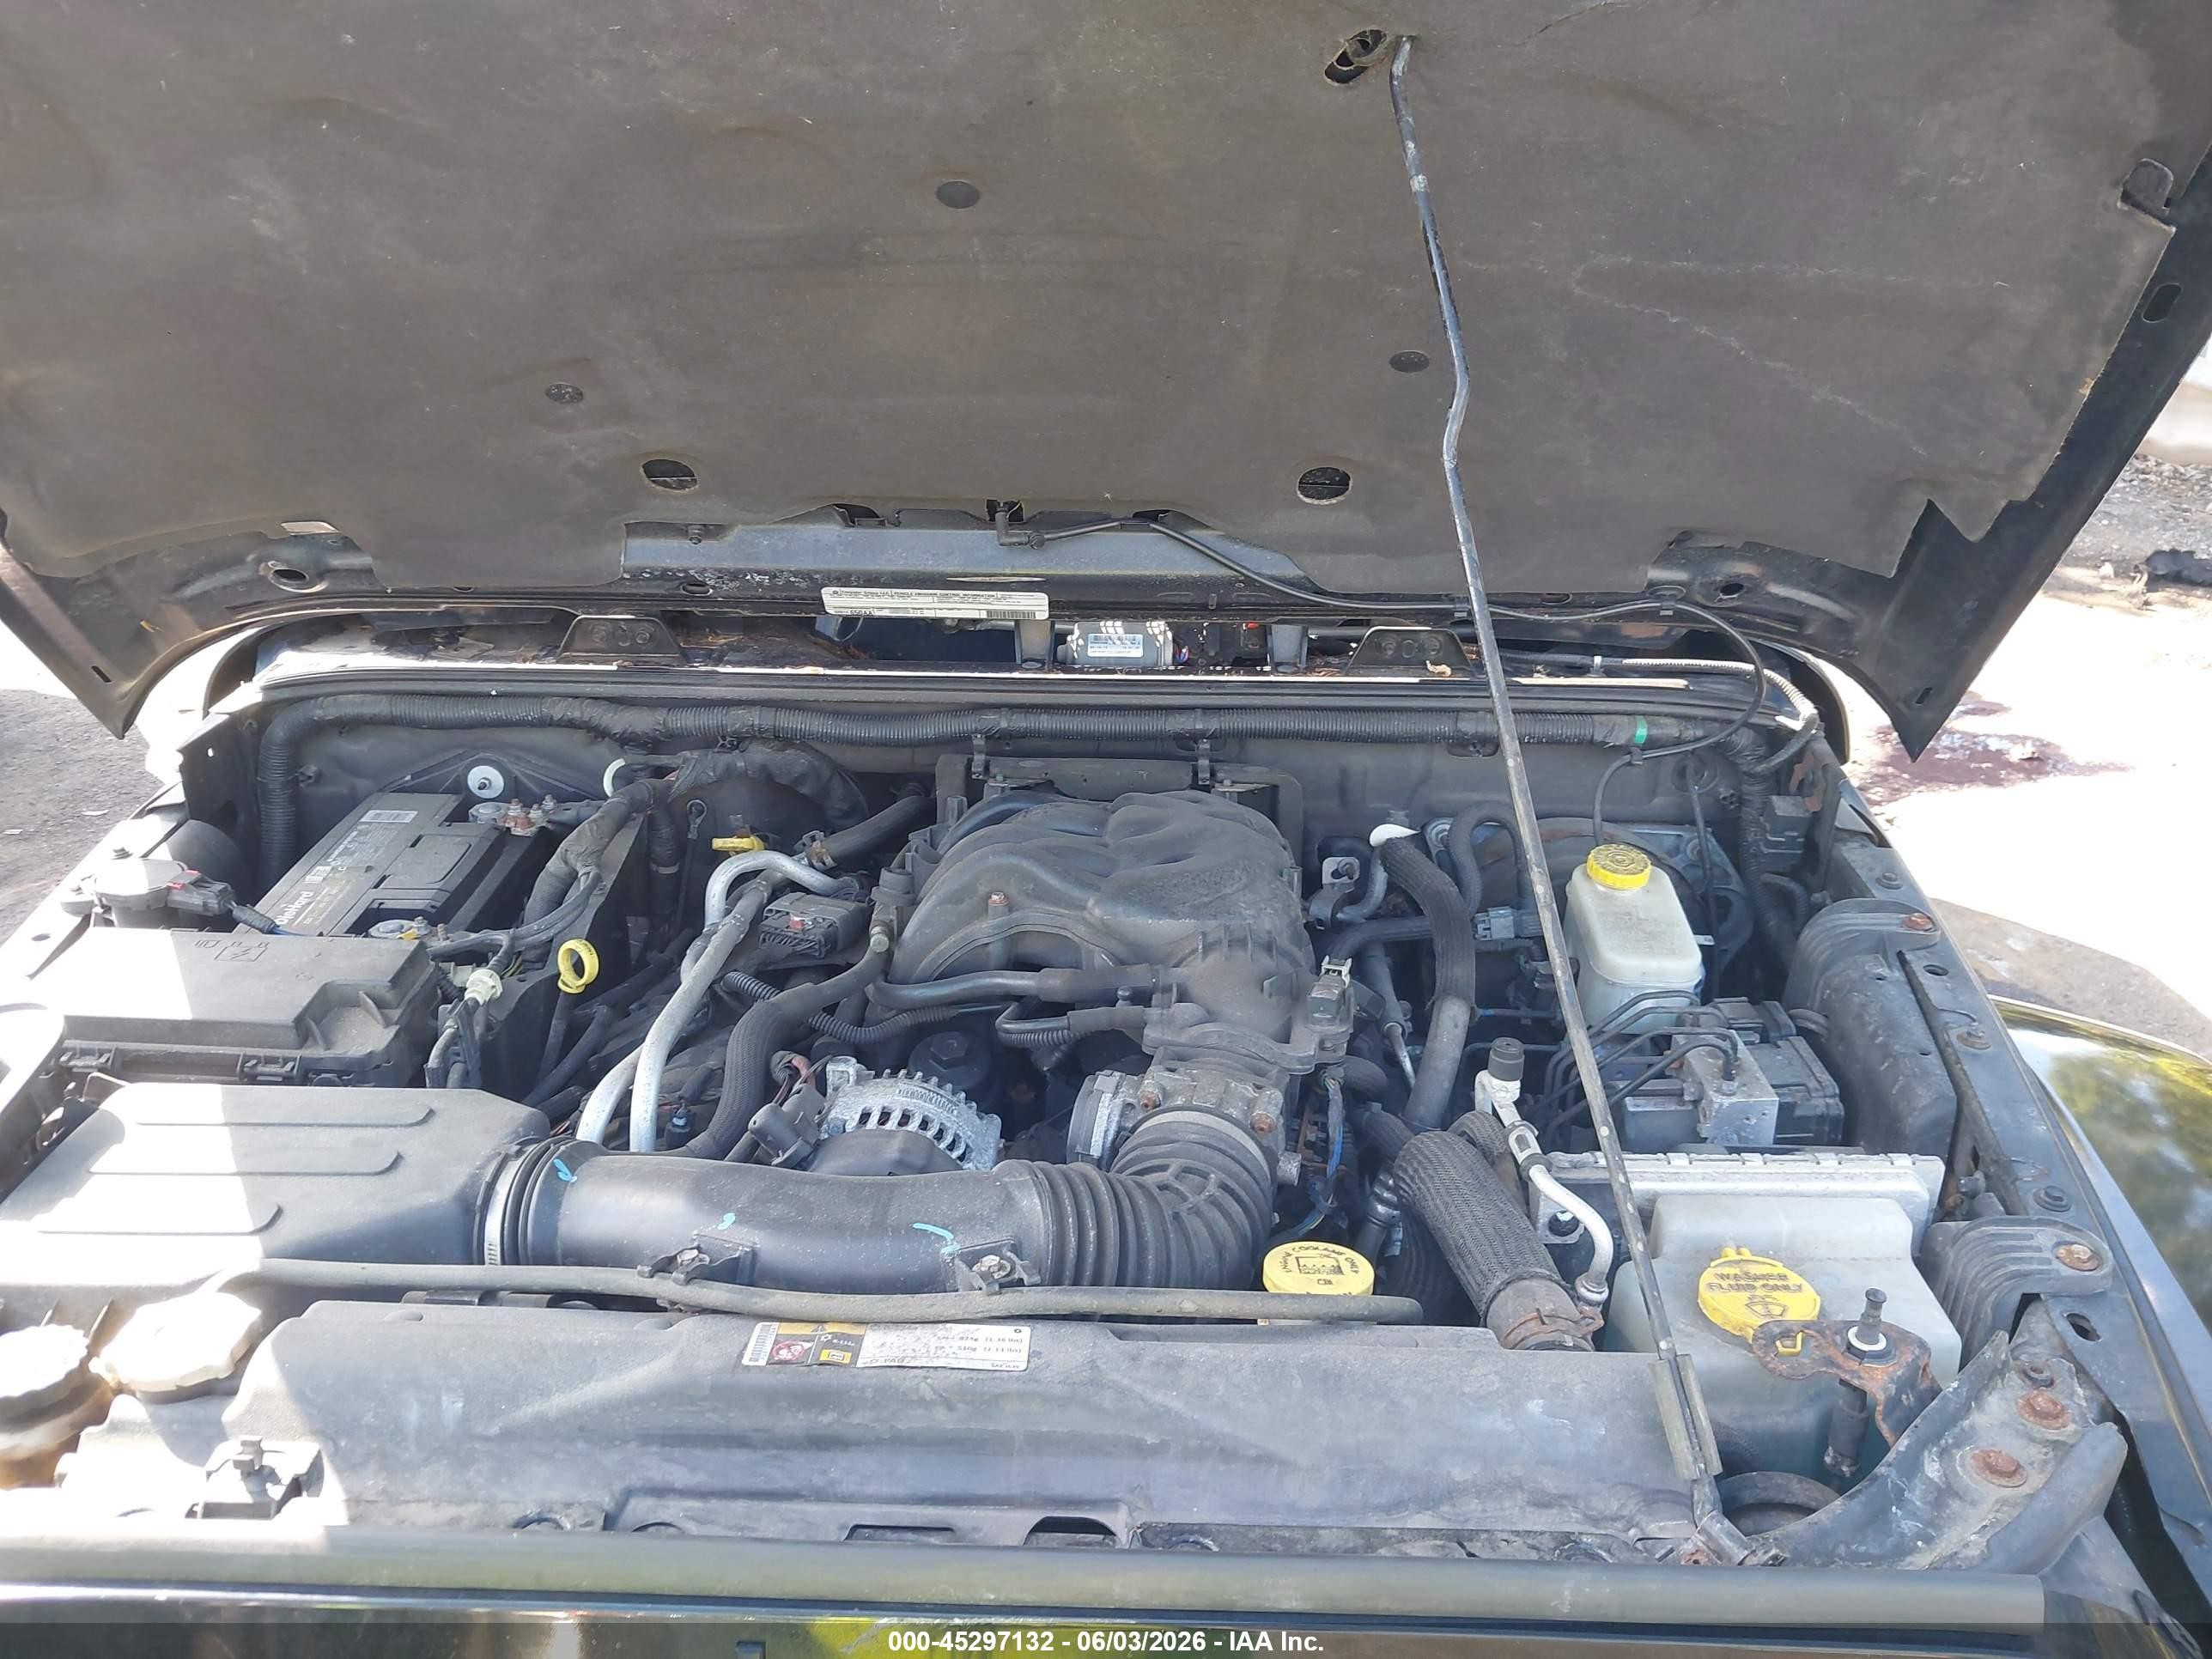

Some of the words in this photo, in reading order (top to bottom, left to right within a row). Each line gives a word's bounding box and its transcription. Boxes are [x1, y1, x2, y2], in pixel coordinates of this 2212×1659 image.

[1292, 1245, 1346, 1256] COOLANT
[1345, 1257, 1360, 1275] ONLY
[1714, 1272, 1790, 1282] WASHER
[1708, 1283, 1757, 1293] FLUID
[1761, 1283, 1802, 1293] ONLY
